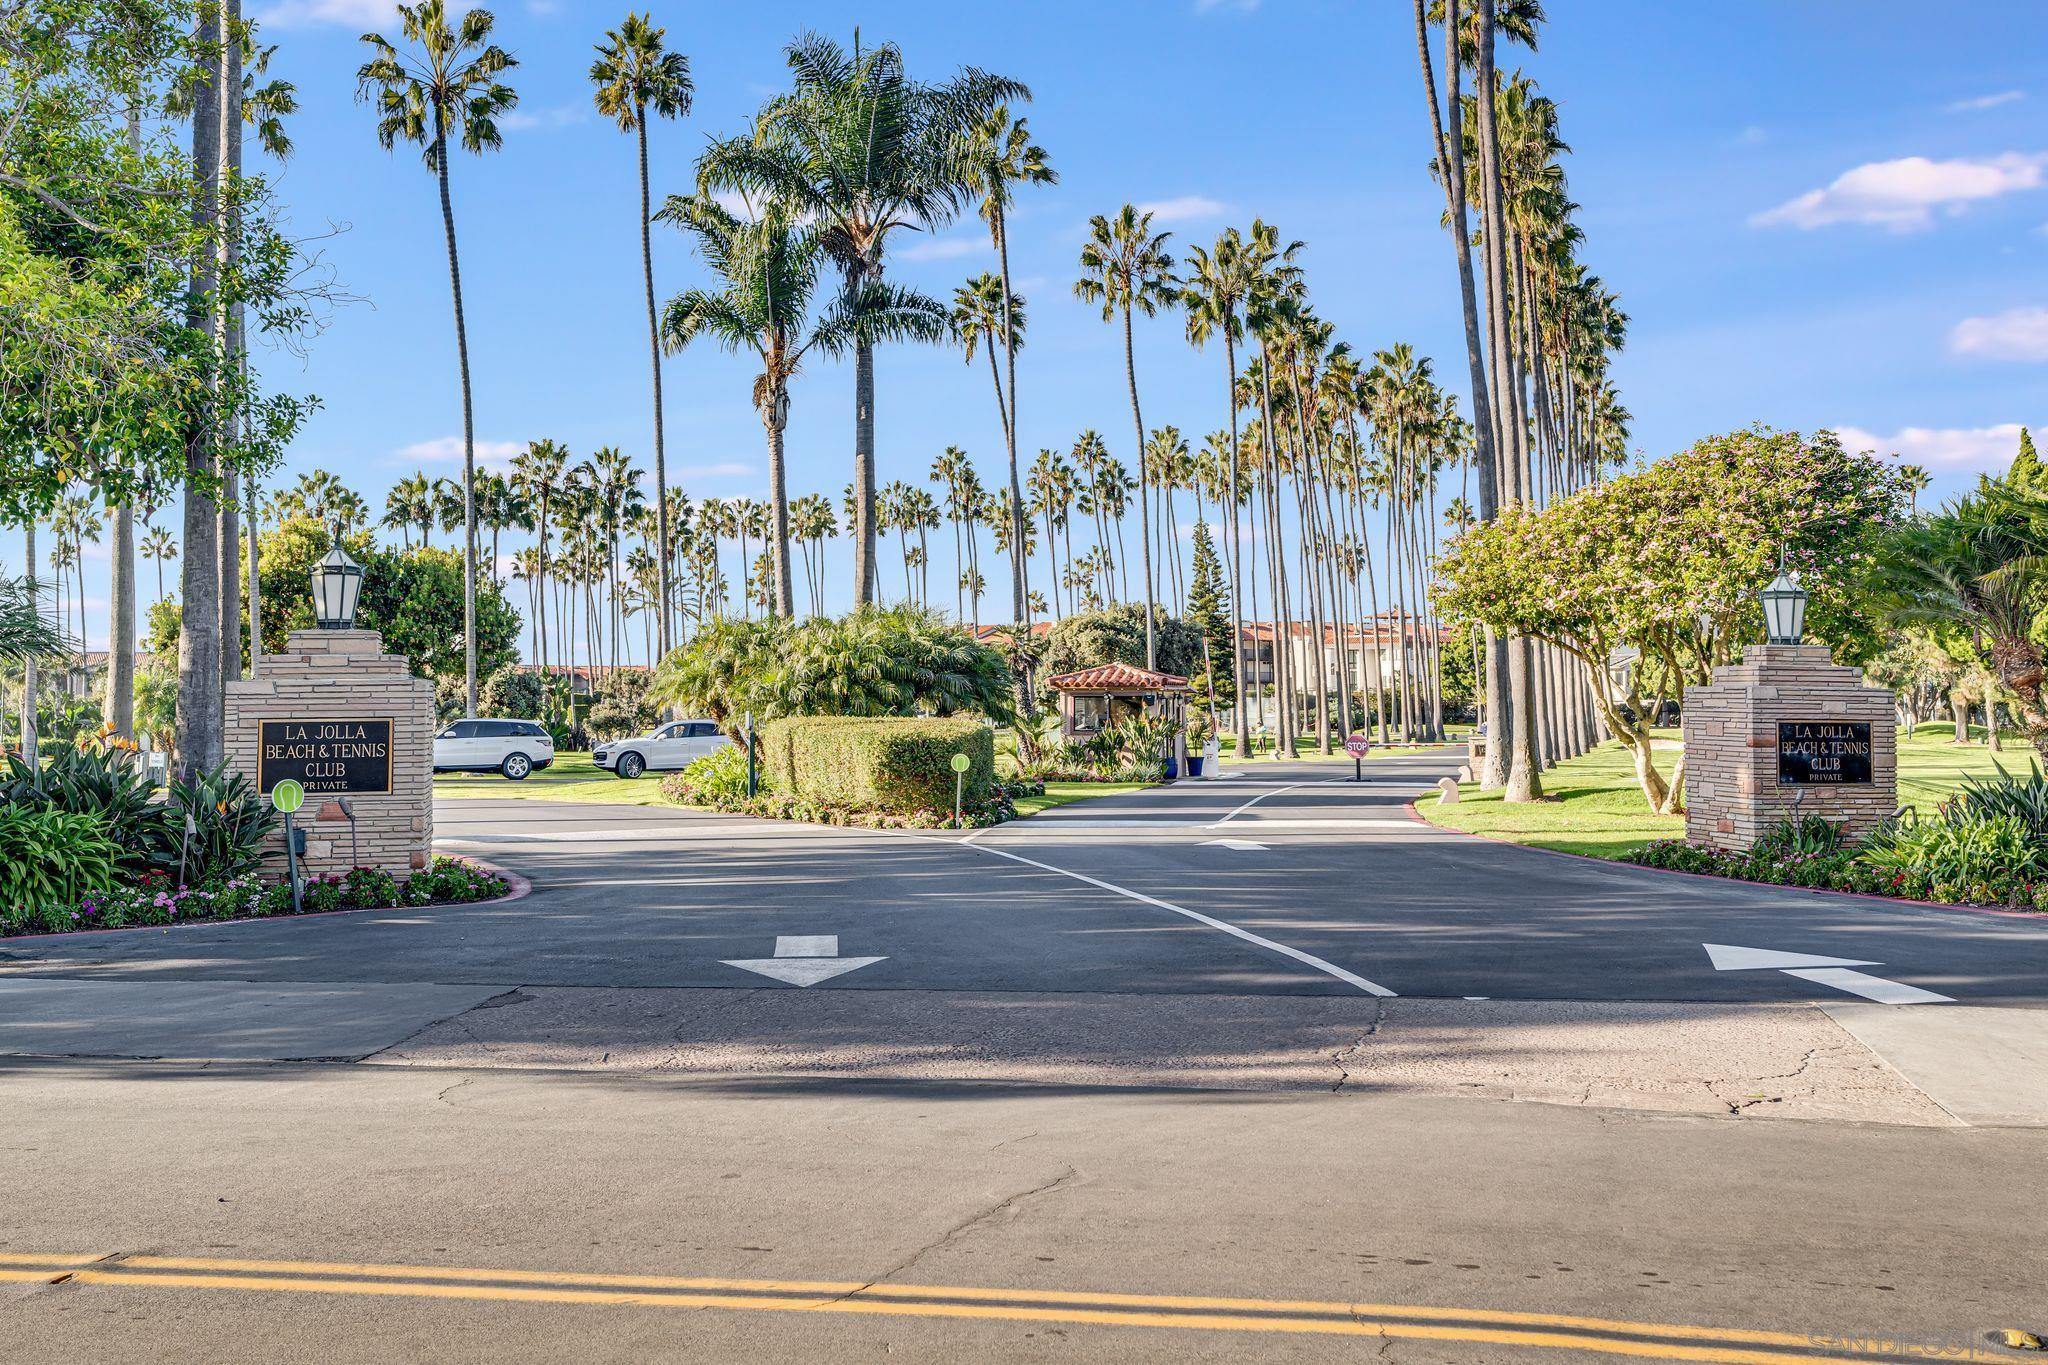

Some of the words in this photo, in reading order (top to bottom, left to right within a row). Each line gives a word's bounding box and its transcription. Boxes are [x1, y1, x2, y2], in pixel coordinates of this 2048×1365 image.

[285, 725, 307, 740] LA
[315, 725, 366, 739] JOLLA
[1795, 726, 1812, 738] LA
[1816, 726, 1854, 739] JOLLA
[266, 744, 315, 759] BEACH
[318, 744, 330, 758] &
[332, 743, 386, 758] TENNIS
[1347, 742, 1367, 751] STOP
[1781, 741, 1818, 754] BEACH
[1820, 742, 1829, 754] &
[1829, 742, 1869, 754] TENNIS
[305, 762, 346, 777] CLUB
[1811, 758, 1841, 770] CLUB
[1809, 773, 1843, 781] PRIVATE
[303, 781, 348, 790] PRIVATE
